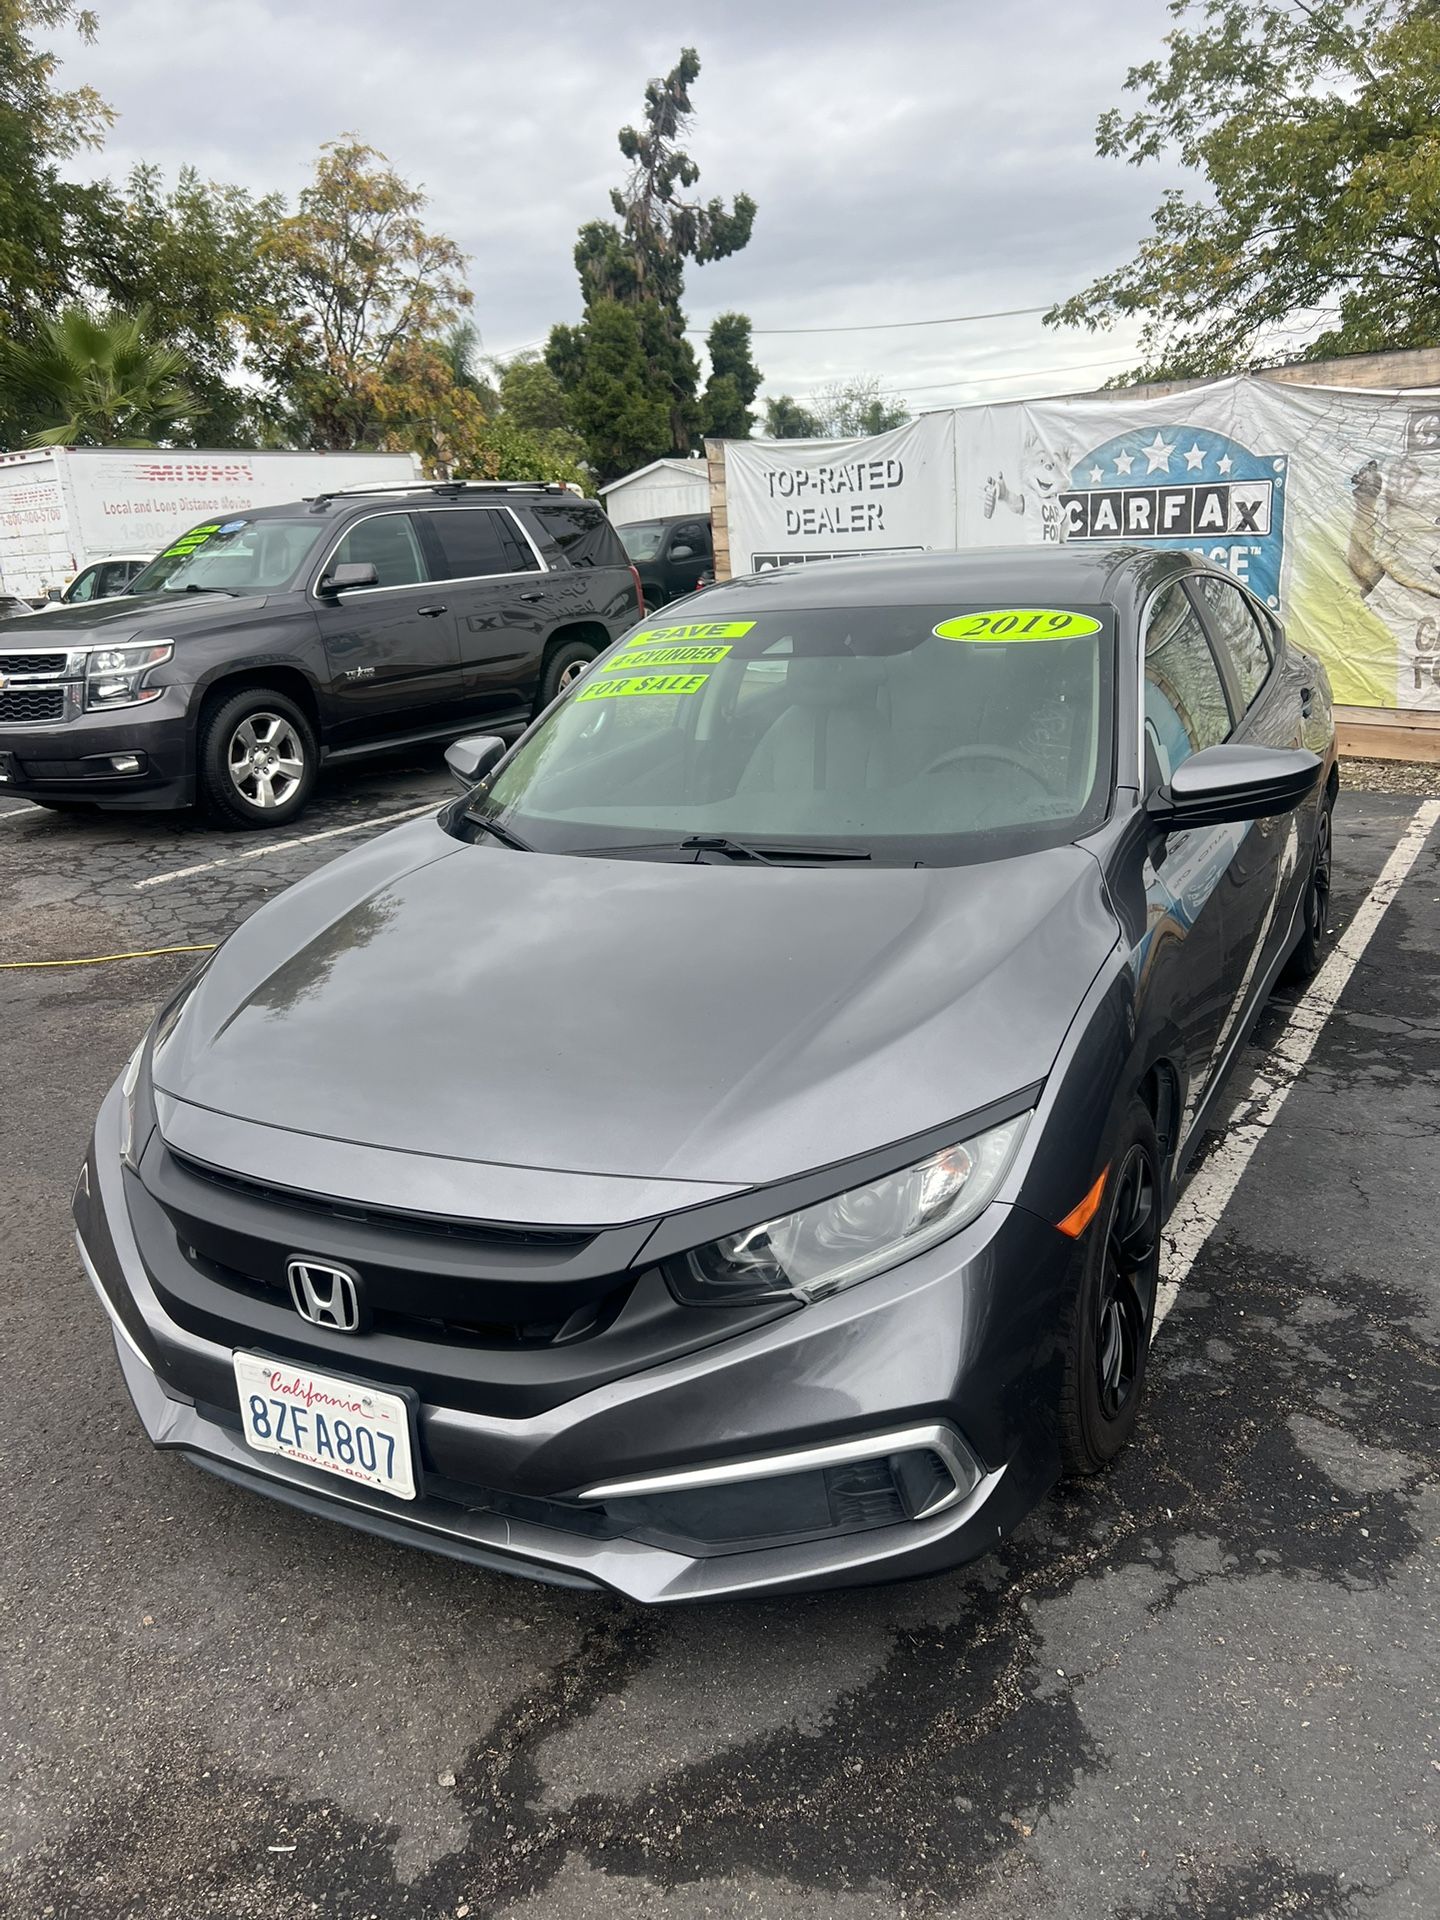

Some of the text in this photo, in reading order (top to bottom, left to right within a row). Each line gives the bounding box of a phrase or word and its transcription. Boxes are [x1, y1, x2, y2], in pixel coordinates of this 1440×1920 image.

[764, 460, 904, 498] TOP-RATED
[103, 500, 132, 515] Local
[134, 499, 152, 513] and
[153, 498, 178, 515] Long
[180, 497, 218, 511] Distance
[786, 503, 885, 535] DEALER
[1065, 493, 1264, 532] CARFAX
[646, 623, 730, 642] SAVE
[960, 615, 1073, 637] 2019
[610, 646, 723, 668] 4-CYLINDER
[581, 676, 703, 698] FOR SALE
[270, 1371, 374, 1419] California
[250, 1395, 395, 1479] 8ZFA807
